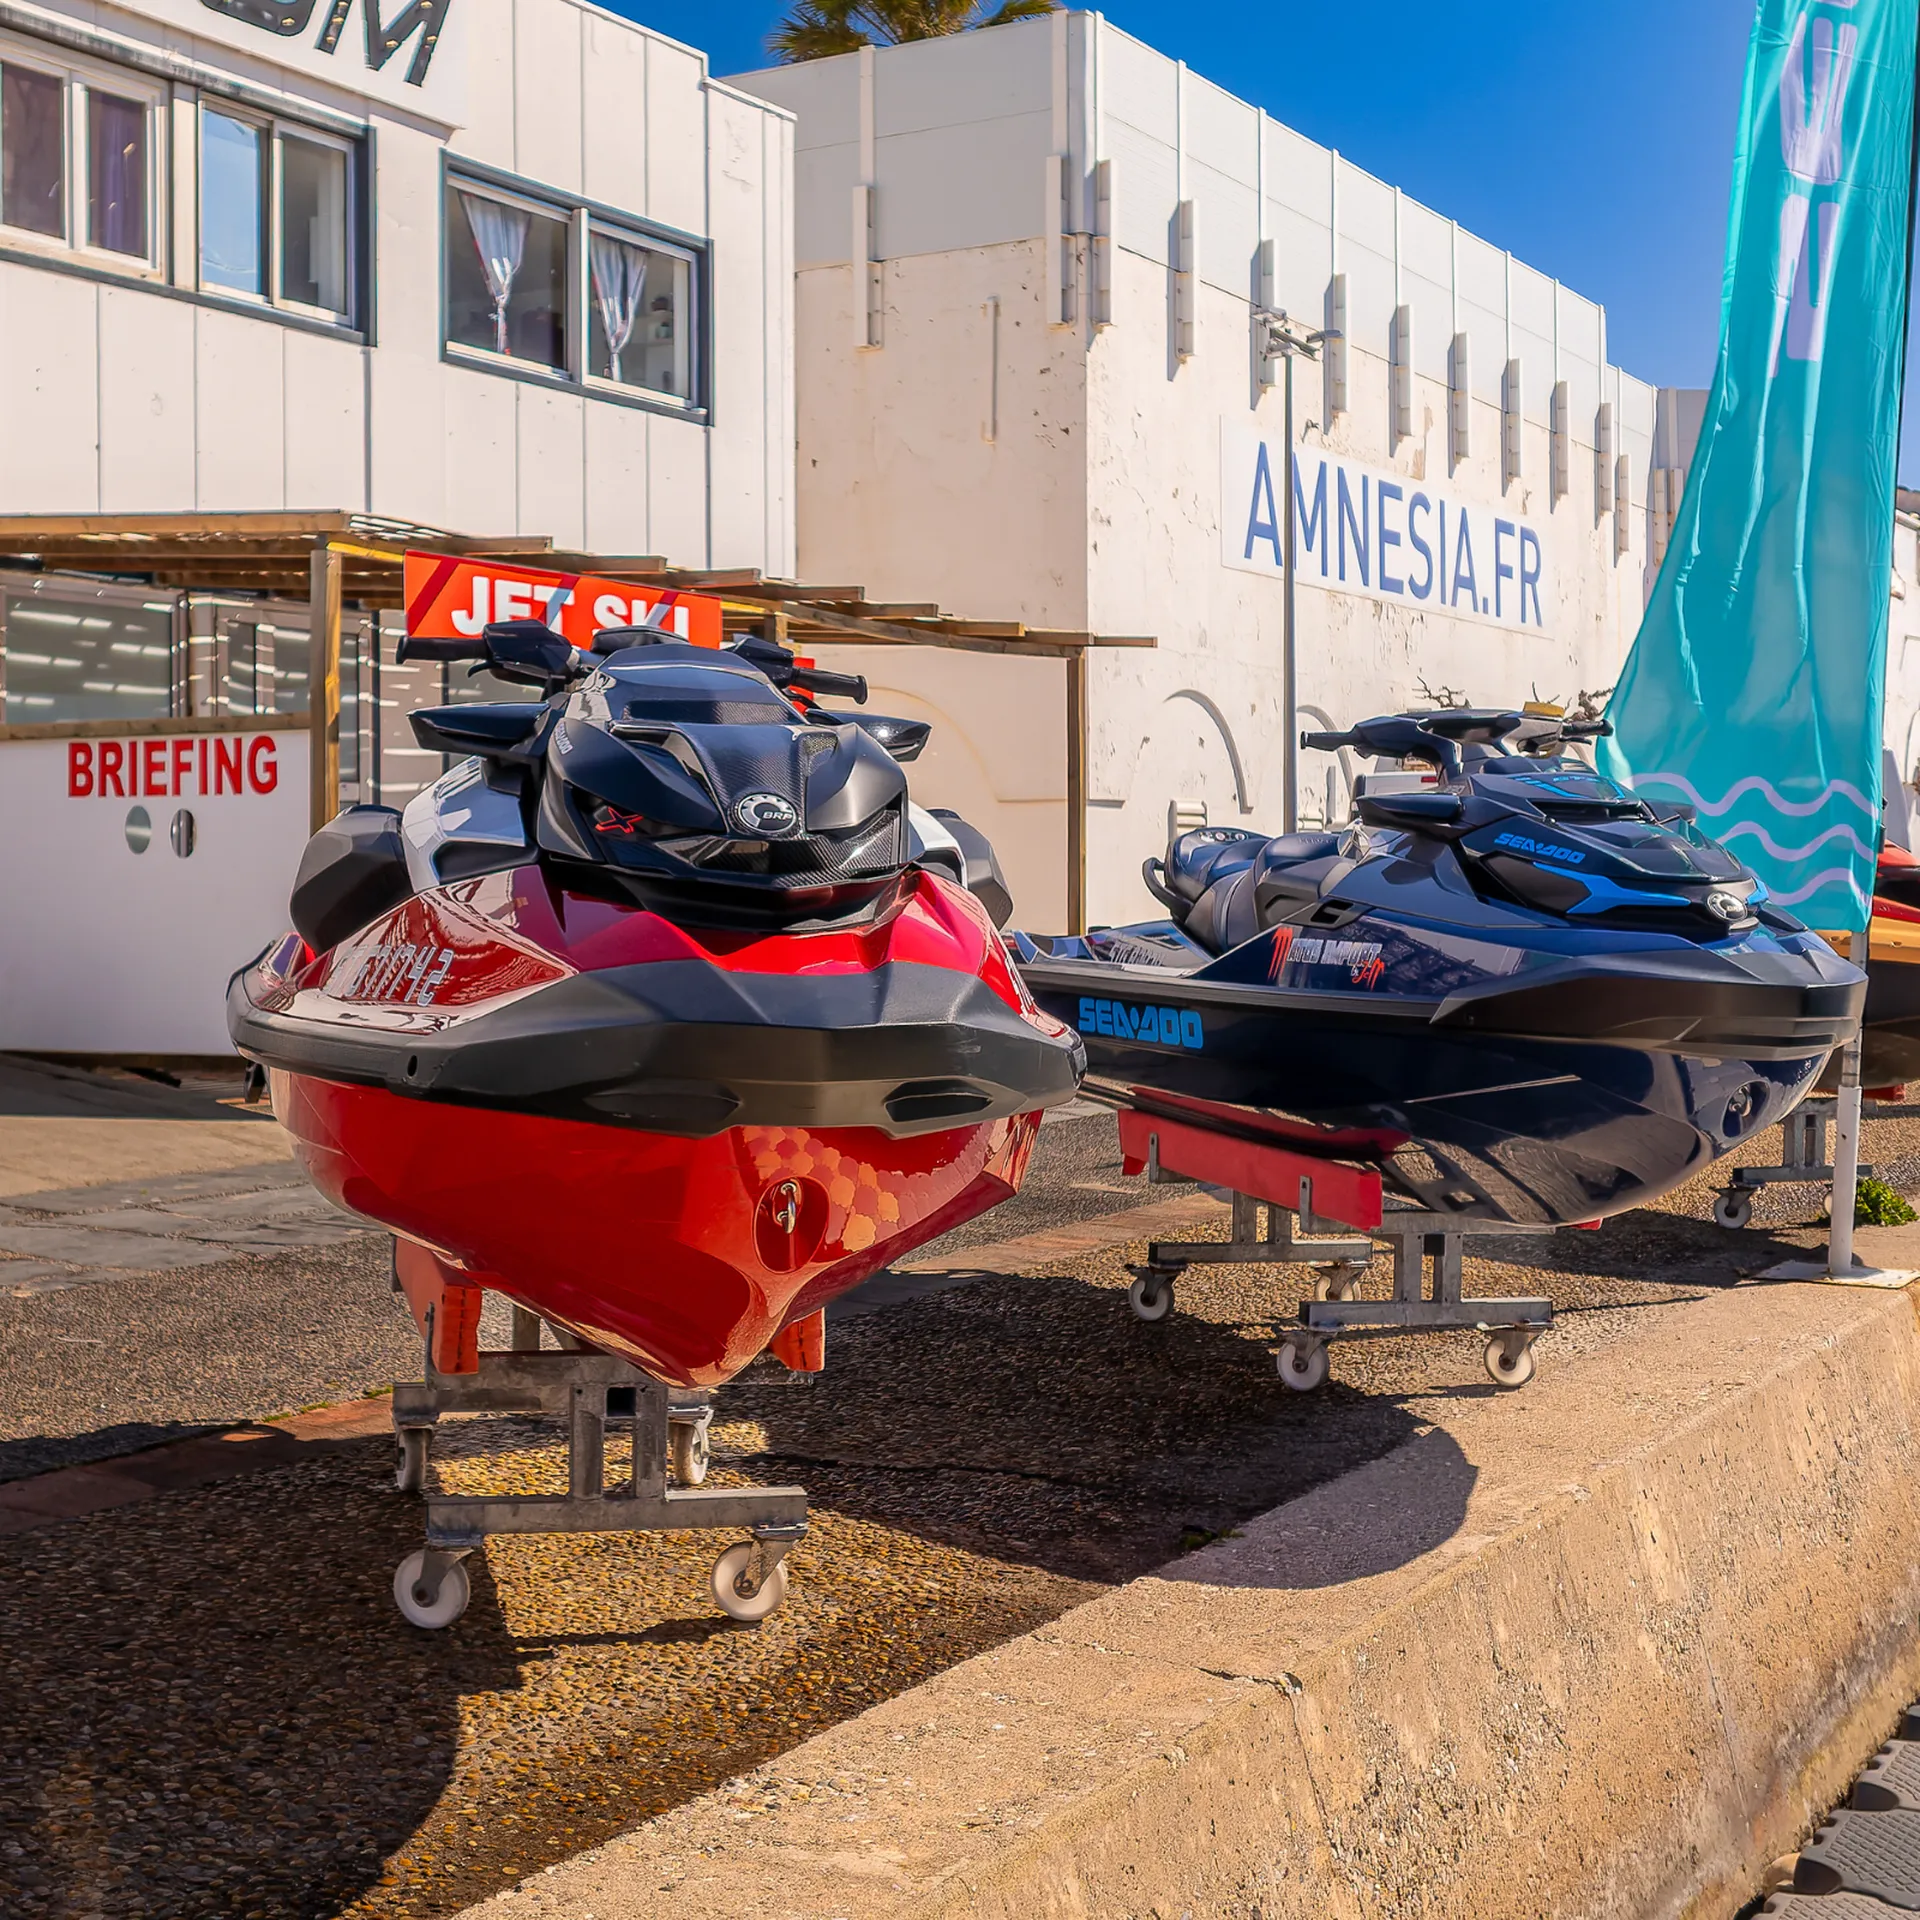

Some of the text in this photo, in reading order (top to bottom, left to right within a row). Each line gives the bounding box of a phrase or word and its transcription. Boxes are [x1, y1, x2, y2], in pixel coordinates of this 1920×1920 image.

[1243, 440, 1543, 628] AMNESIA.FR
[451, 575, 690, 642] JET SKI
[67, 735, 278, 798] BRIEFING
